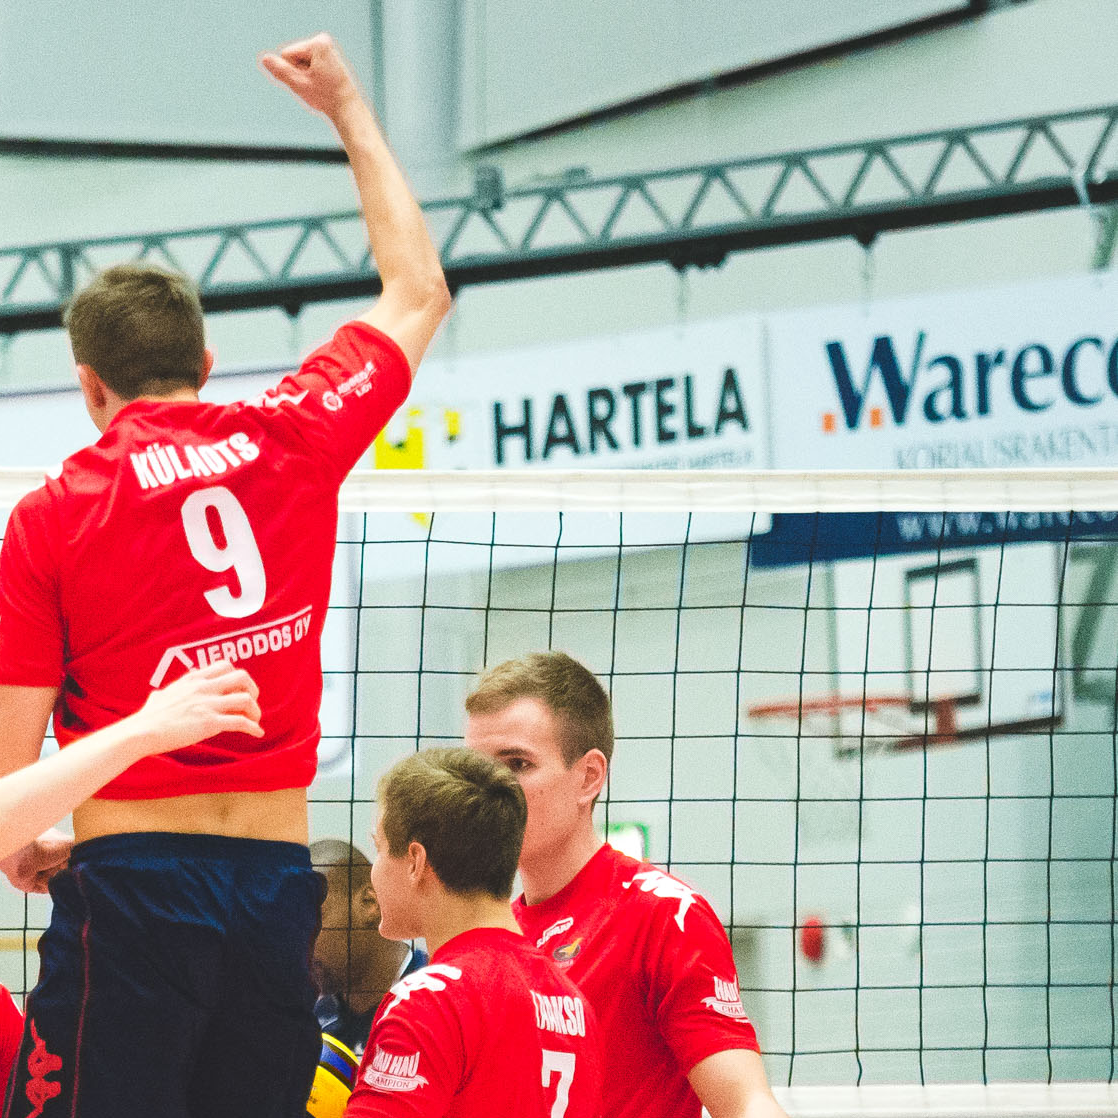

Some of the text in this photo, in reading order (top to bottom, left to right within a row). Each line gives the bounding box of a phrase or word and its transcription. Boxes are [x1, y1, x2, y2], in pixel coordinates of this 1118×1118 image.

[493, 367, 749, 465] HARTELA
[824, 329, 1118, 430] Warec
[129, 431, 261, 490] KÜLAOTS
[180, 486, 267, 619] 9
